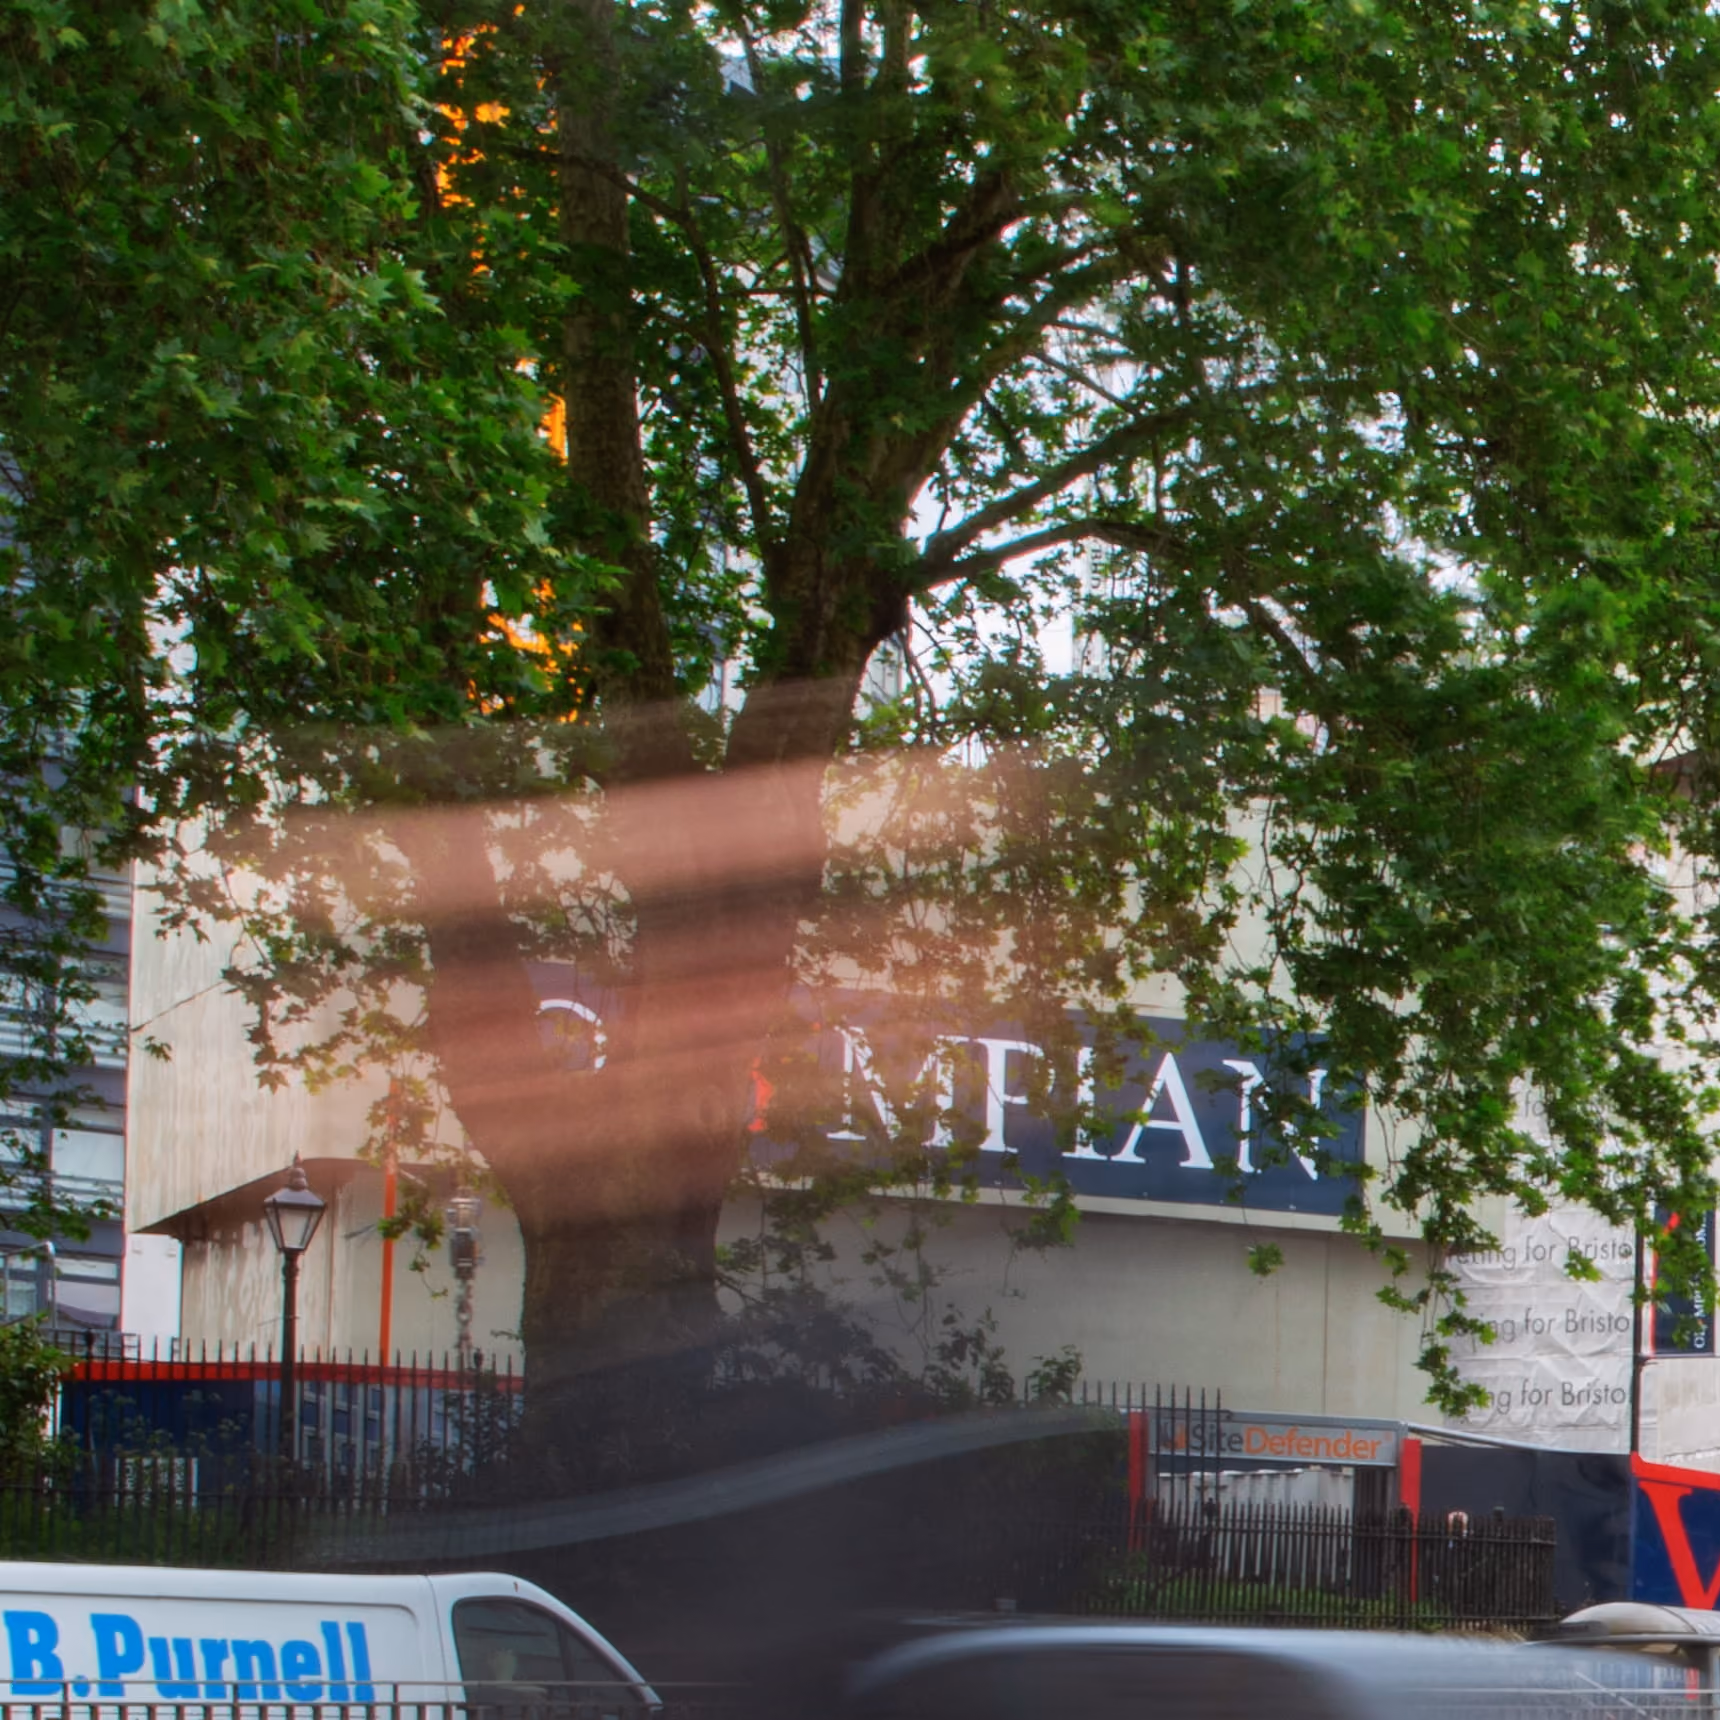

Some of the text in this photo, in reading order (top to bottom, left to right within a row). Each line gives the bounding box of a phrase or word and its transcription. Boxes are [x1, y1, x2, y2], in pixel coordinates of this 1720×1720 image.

[1523, 1235, 1556, 1262] for
[1525, 1308, 1556, 1336] for
[1521, 1378, 1553, 1406] for
